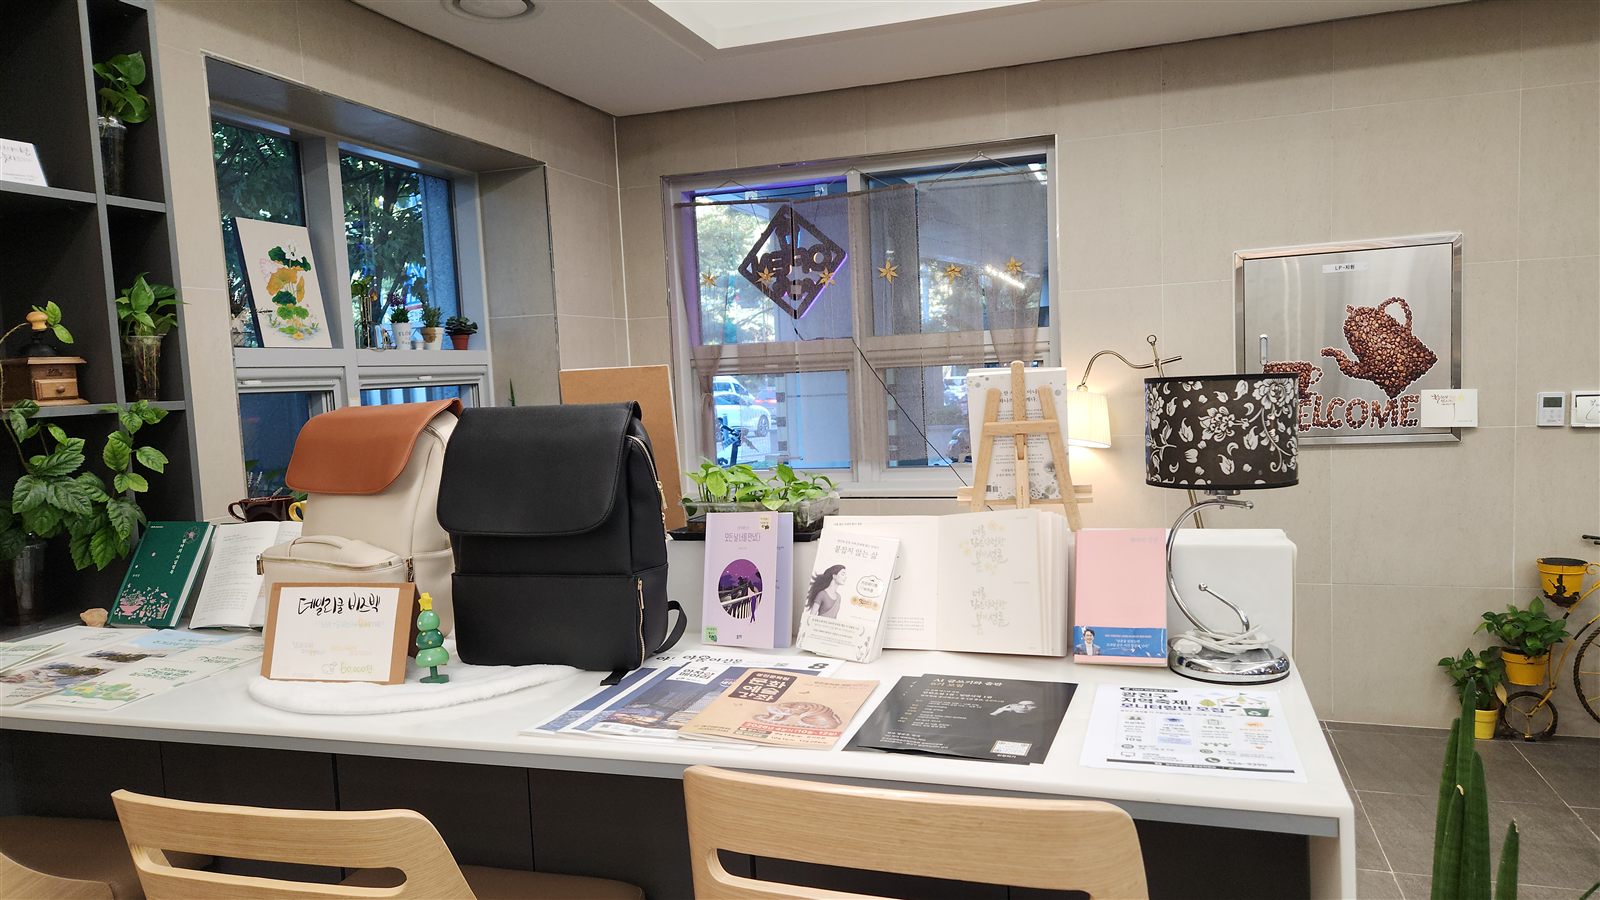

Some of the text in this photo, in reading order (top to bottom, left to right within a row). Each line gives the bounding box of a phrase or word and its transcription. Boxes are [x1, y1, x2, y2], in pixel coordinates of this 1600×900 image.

[1298, 393, 1420, 432] ELCOME
[749, 677, 786, 689] 문화
[742, 684, 779, 695] 예술
[738, 691, 774, 701] 강좌
[1121, 691, 1168, 699] 광진구
[1121, 697, 1188, 705] 지역축제
[1121, 703, 1192, 711] 모니터링단
